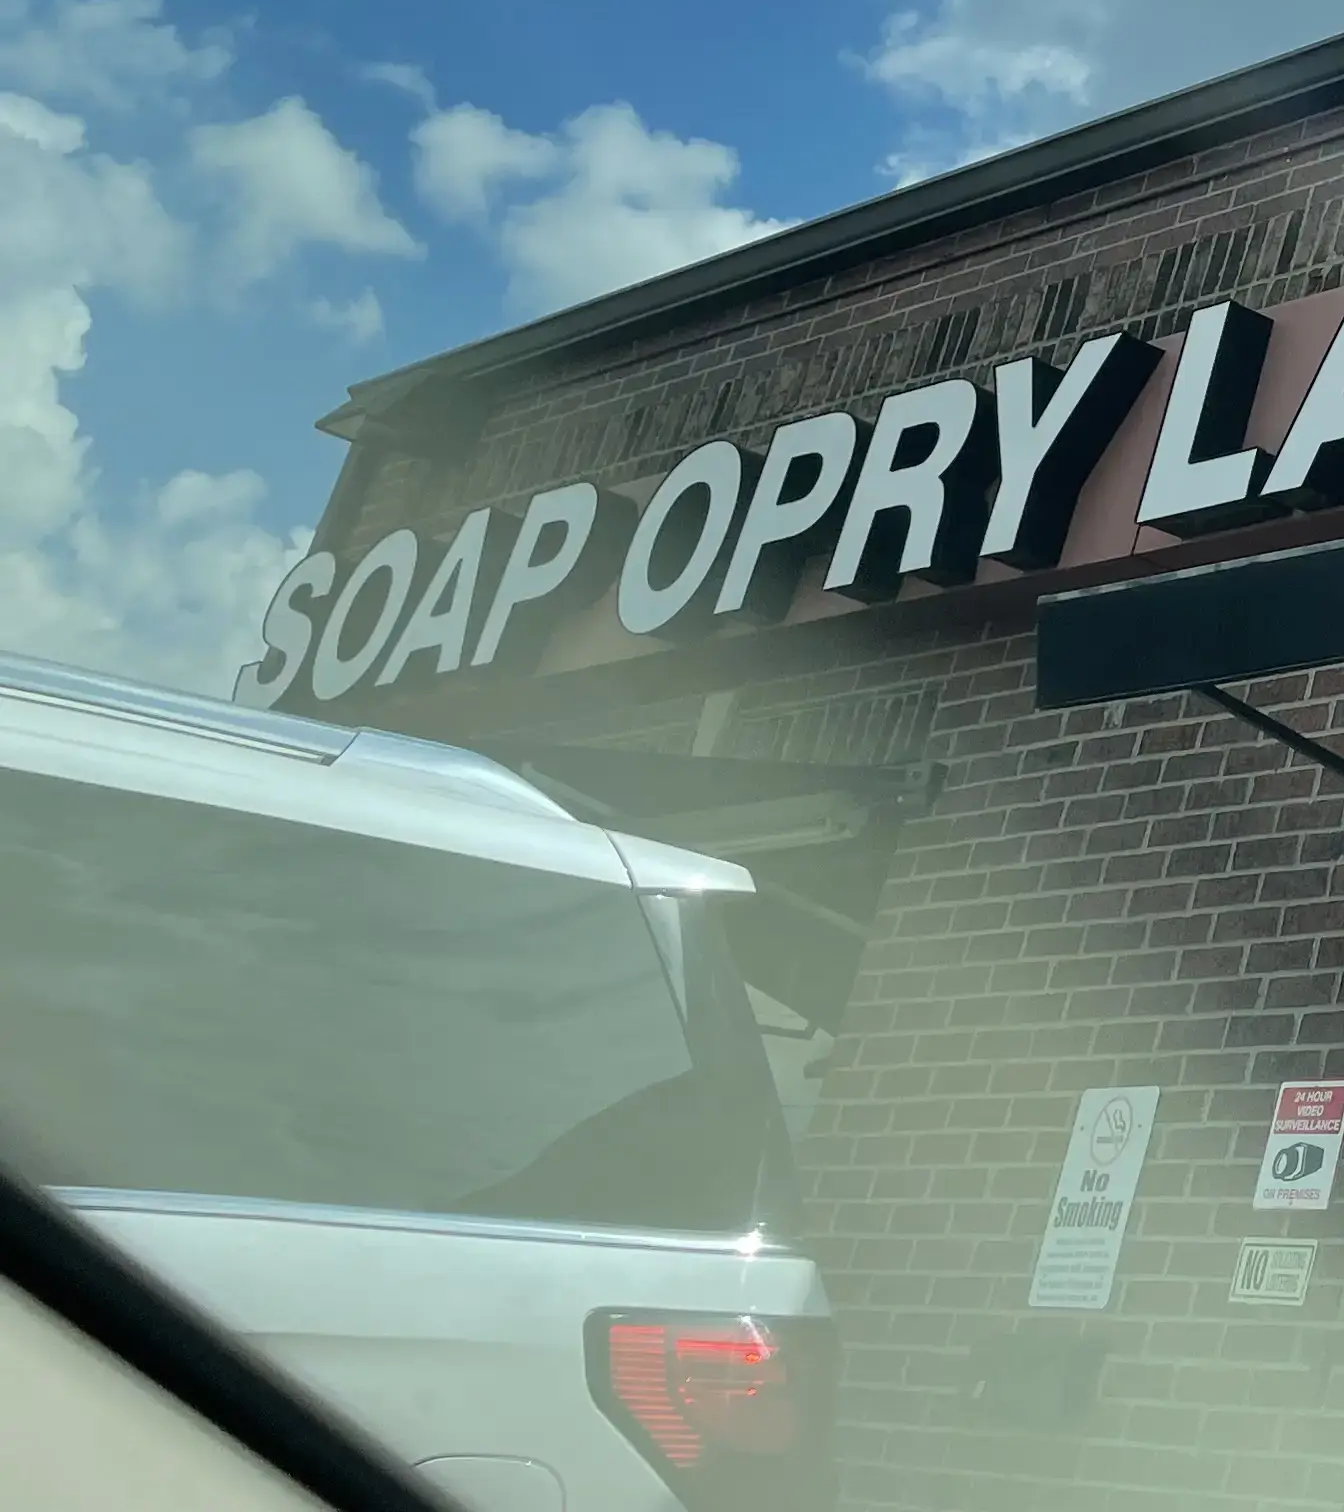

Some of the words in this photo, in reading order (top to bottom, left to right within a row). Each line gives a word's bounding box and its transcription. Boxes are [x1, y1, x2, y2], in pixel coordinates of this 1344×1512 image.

[234, 483, 598, 710] SOAP
[618, 332, 1125, 635] OPRY
[1294, 1091, 1306, 1103] 24
[1307, 1090, 1333, 1103] HOUR
[1297, 1105, 1324, 1117] VIDEO
[1275, 1119, 1341, 1131] SURVEILLANCE
[1079, 1169, 1109, 1193] No
[1276, 1189, 1321, 1200] PREMISES
[1053, 1196, 1123, 1231] Smoking
[1240, 1249, 1270, 1290] NO
